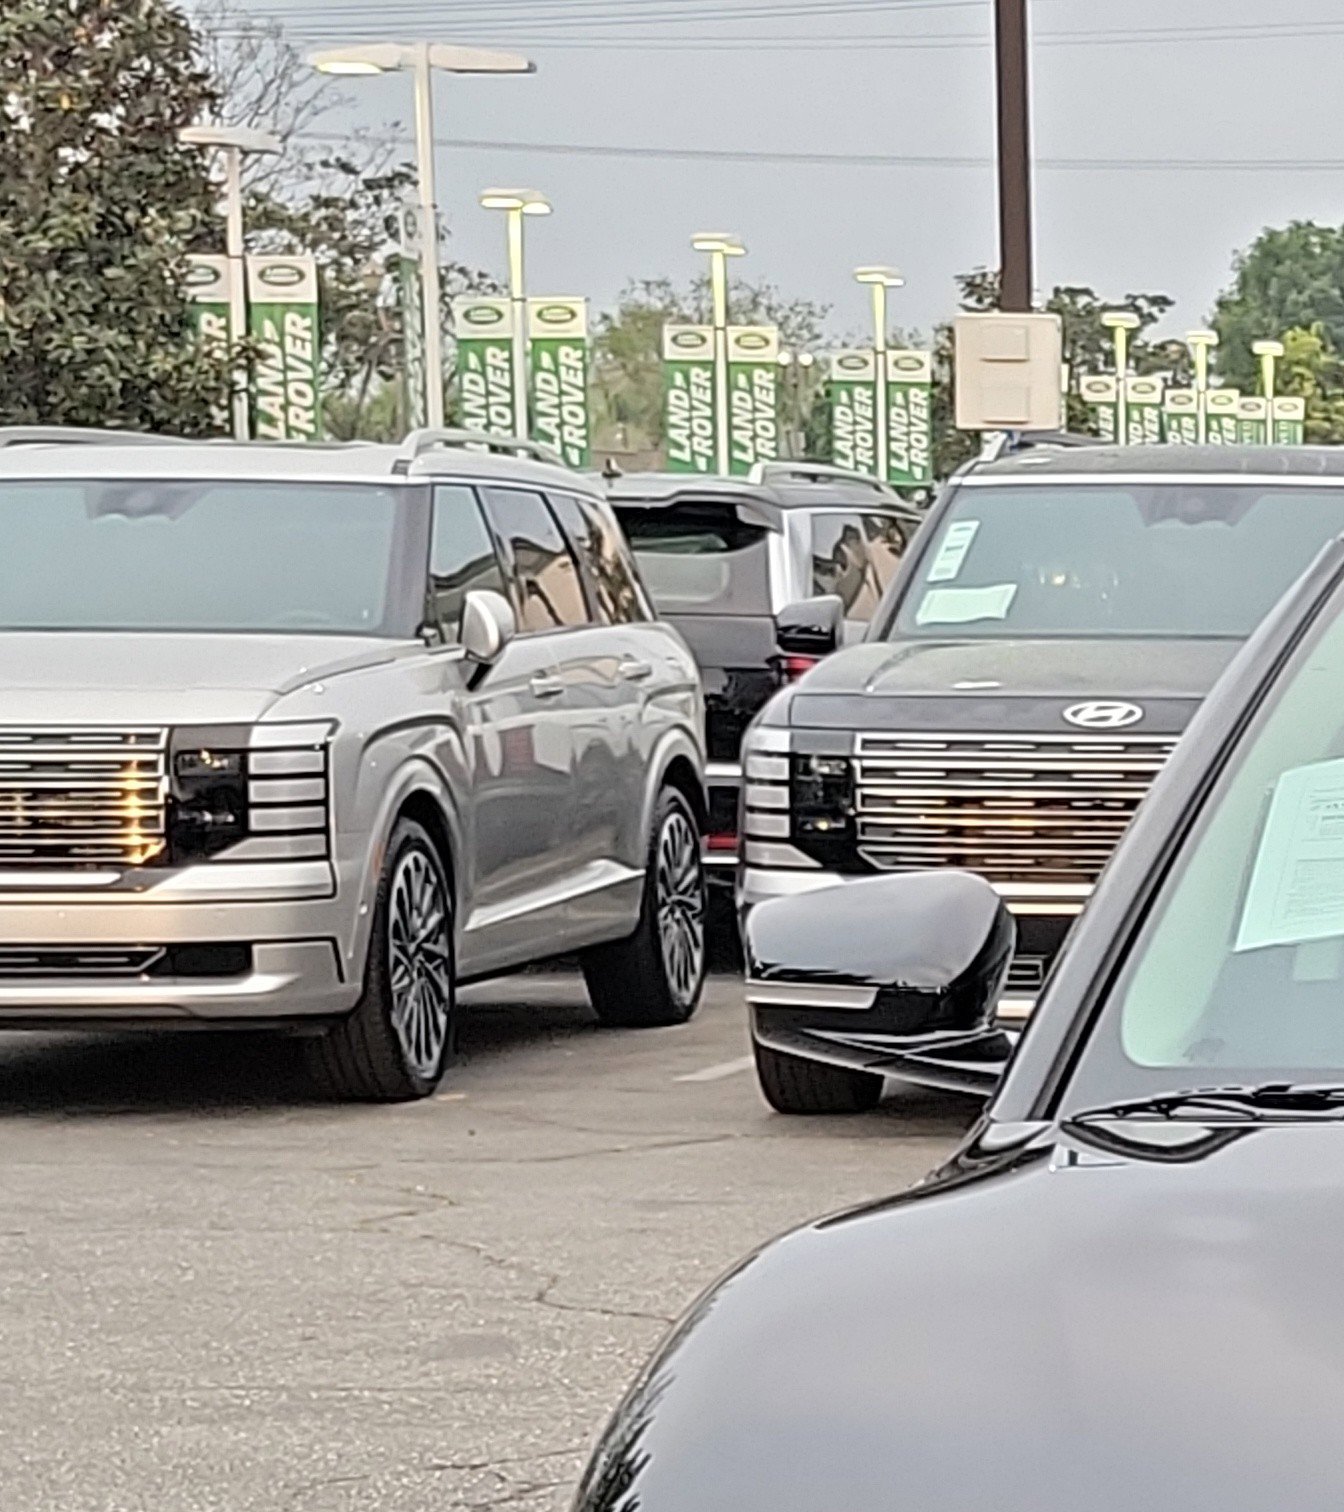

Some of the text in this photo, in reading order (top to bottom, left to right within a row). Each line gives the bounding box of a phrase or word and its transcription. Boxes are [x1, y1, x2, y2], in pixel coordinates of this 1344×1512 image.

[256, 343, 286, 440] LAND
[285, 312, 316, 434] ROVER
[462, 373, 488, 434] AND
[559, 346, 588, 449] ROVER
[690, 367, 714, 457] ROVER
[536, 372, 562, 456] LAND
[668, 389, 692, 463] LAND
[731, 390, 755, 464] LAND
[752, 368, 777, 458] ROVER
[833, 405, 854, 470] LAND
[853, 386, 874, 466] ROVER
[889, 407, 909, 472] LAND
[908, 388, 929, 467] ROVER
[1099, 405, 1114, 441] VER
[1143, 407, 1159, 443] VER
